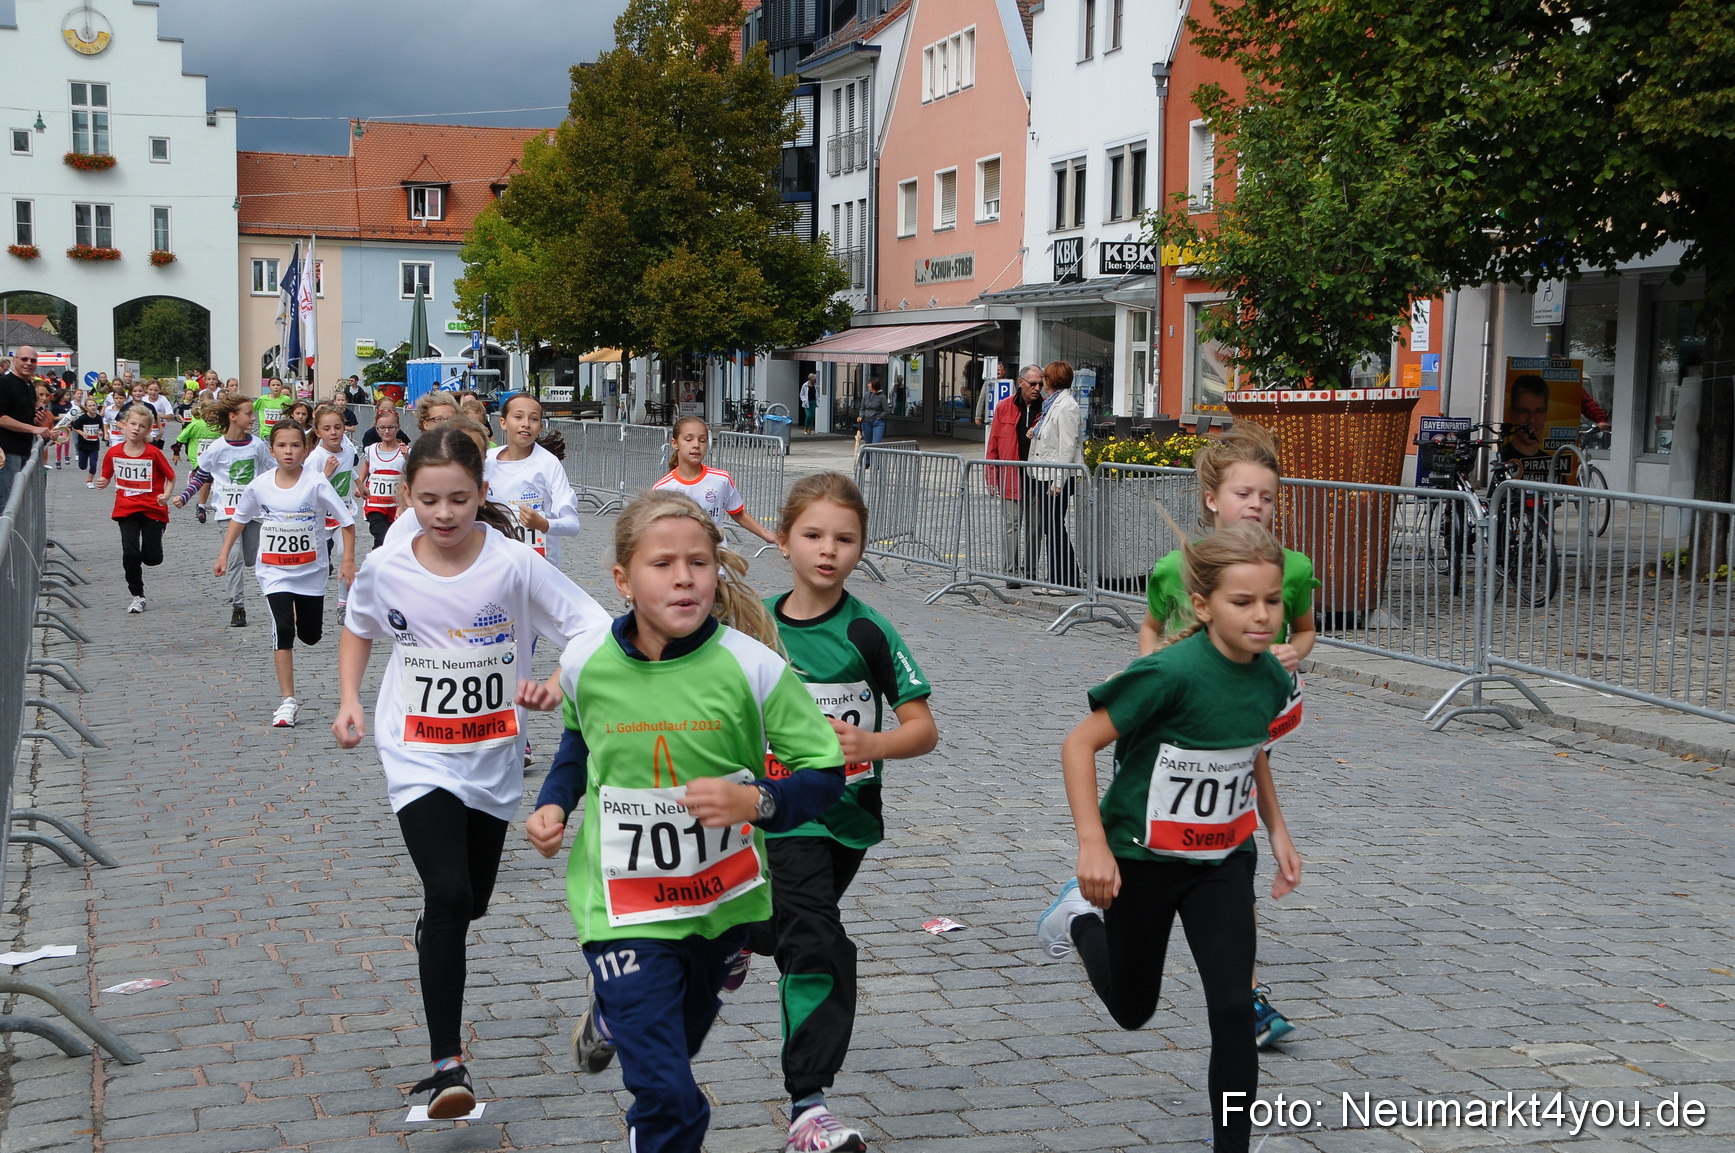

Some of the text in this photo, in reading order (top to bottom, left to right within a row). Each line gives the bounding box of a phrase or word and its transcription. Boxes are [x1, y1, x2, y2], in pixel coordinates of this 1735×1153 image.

[1056, 240, 1078, 265] KBK
[1105, 244, 1156, 262] KBK
[473, 334, 479, 344] P
[1512, 360, 1550, 368] ZUHÖREN
[1543, 371, 1578, 380] ABHÖREN
[1001, 385, 1009, 394] P
[118, 465, 148, 480] 7014
[1524, 460, 1568, 471] PIRATN
[1524, 474, 1562, 483] WÄHLN
[266, 535, 310, 553] 7286
[279, 556, 300, 564] Lucia
[404, 656, 499, 670] PARTL Neumarkt
[896, 650, 913, 673] erima
[415, 672, 504, 715] 7280
[815, 693, 854, 706] umarkt
[414, 718, 507, 740] Anna-Maria
[606, 720, 722, 733] 1. Goldhutlauf 2012
[1159, 756, 1204, 773] PARTL
[1169, 770, 1255, 818] 7019
[603, 801, 651, 816] PARTL
[1182, 828, 1236, 849] Svenja
[654, 876, 725, 904] Janika
[595, 949, 641, 982] 112
